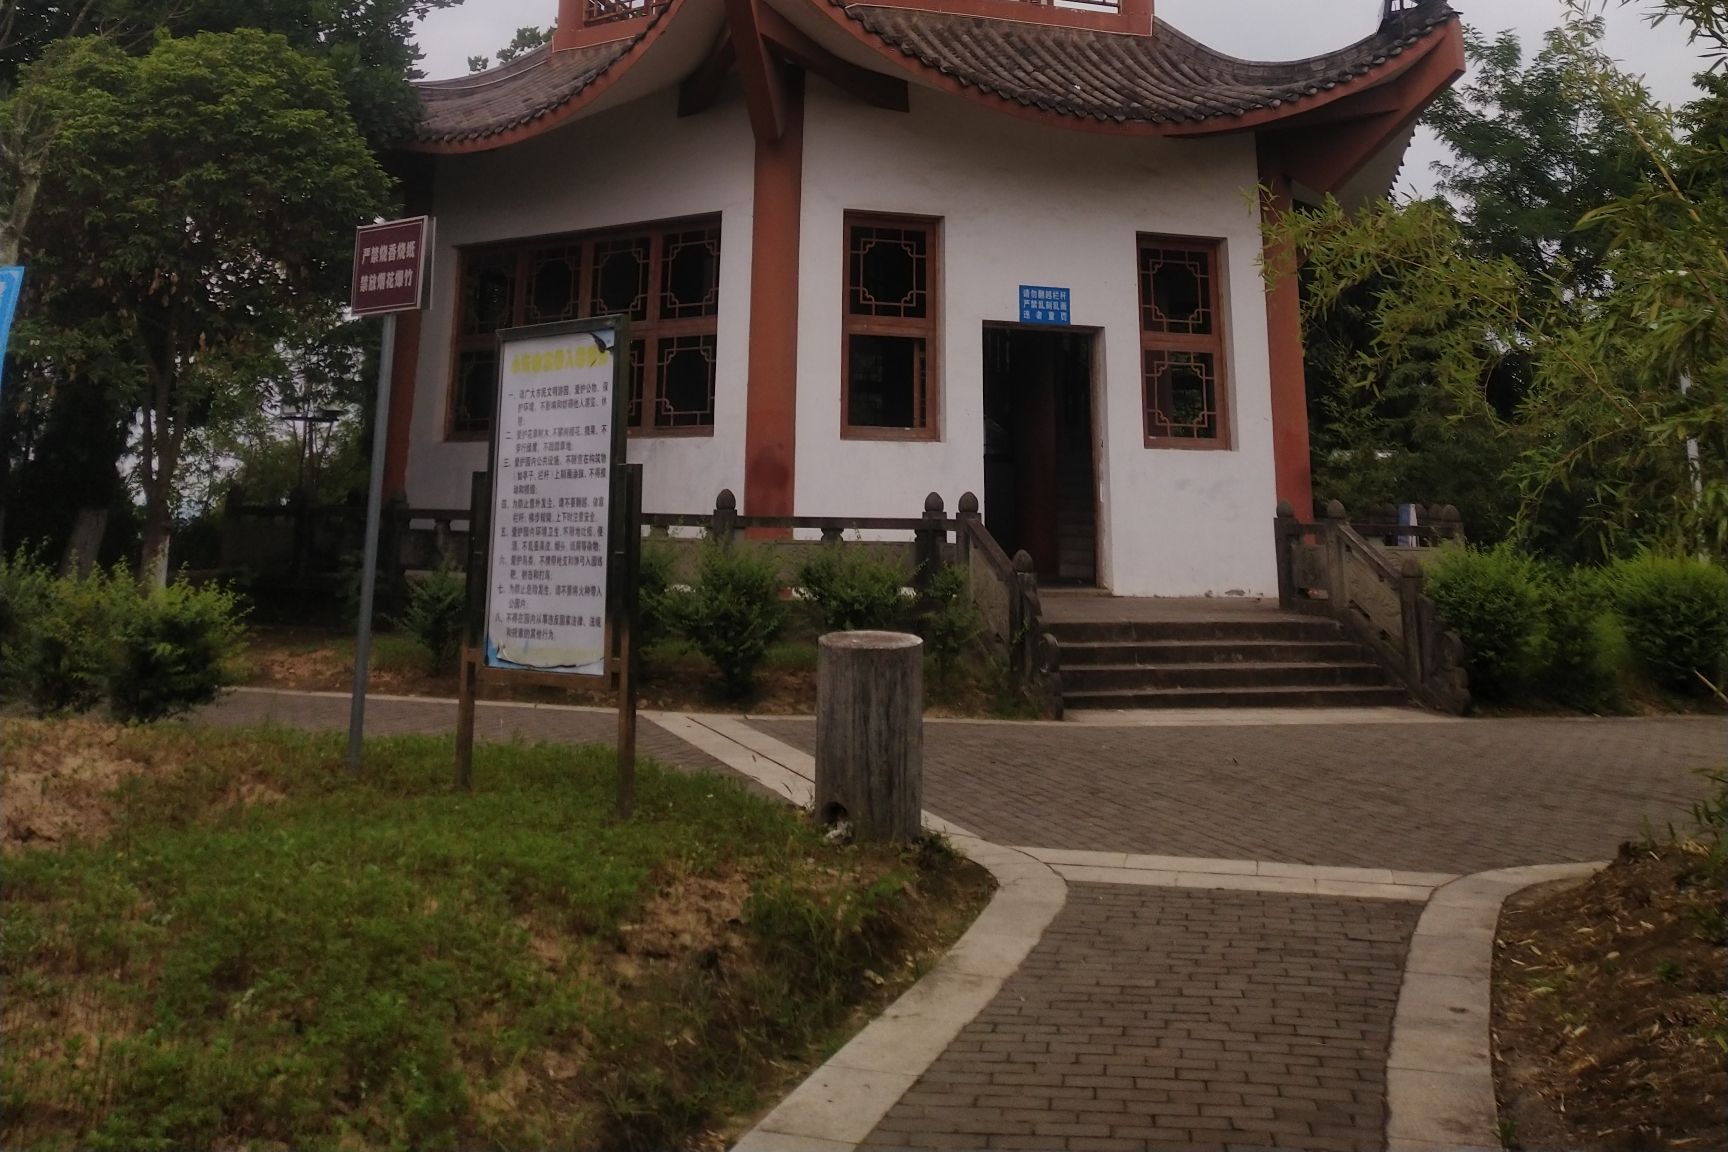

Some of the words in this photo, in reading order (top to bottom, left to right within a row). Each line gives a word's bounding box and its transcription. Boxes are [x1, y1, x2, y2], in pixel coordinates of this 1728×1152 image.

[362, 241, 416, 264] 严禁烧香烧纸
[360, 269, 413, 293] 禁放烟花爆竹
